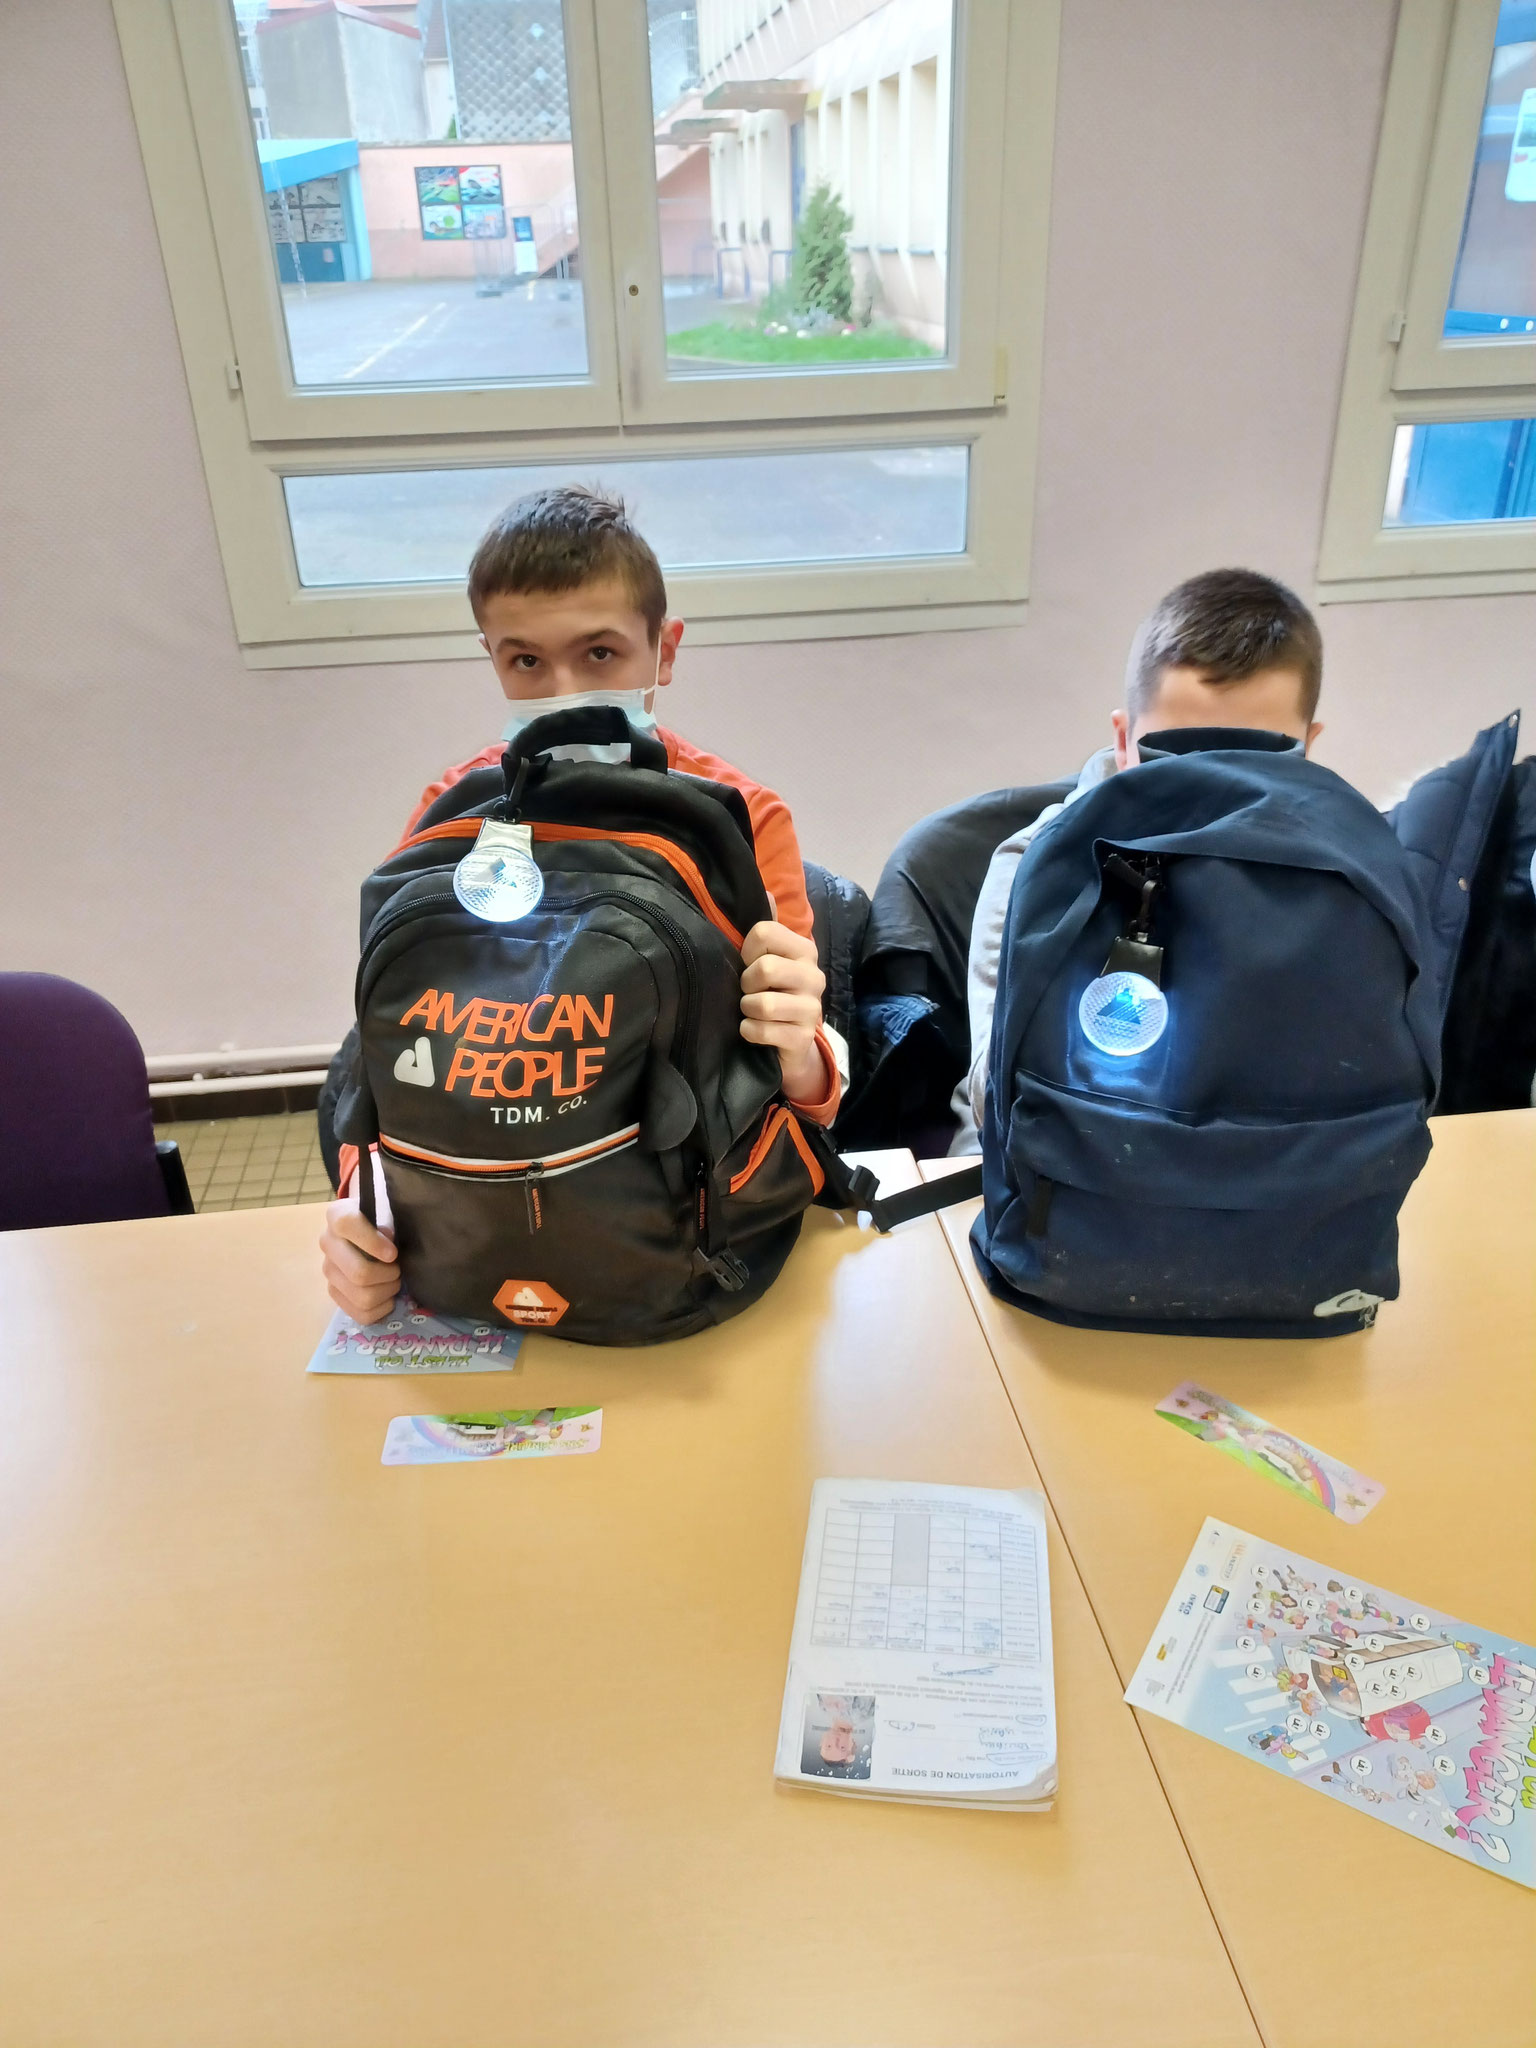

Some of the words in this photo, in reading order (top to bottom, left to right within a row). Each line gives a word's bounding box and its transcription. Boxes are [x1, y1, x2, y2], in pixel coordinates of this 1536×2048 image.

[400, 989, 614, 1044] AMERICAN
[444, 1047, 606, 1098] PEOPLE
[513, 1310, 551, 1320] SPORT
[351, 1332, 473, 1356] DANGER
[474, 1332, 507, 1354] LE
[1455, 1687, 1536, 1828] DANGER
[891, 1767, 928, 1778] SORTIE
[930, 1771, 944, 1779] DE
[945, 1770, 1020, 1780] AUTORISATION
